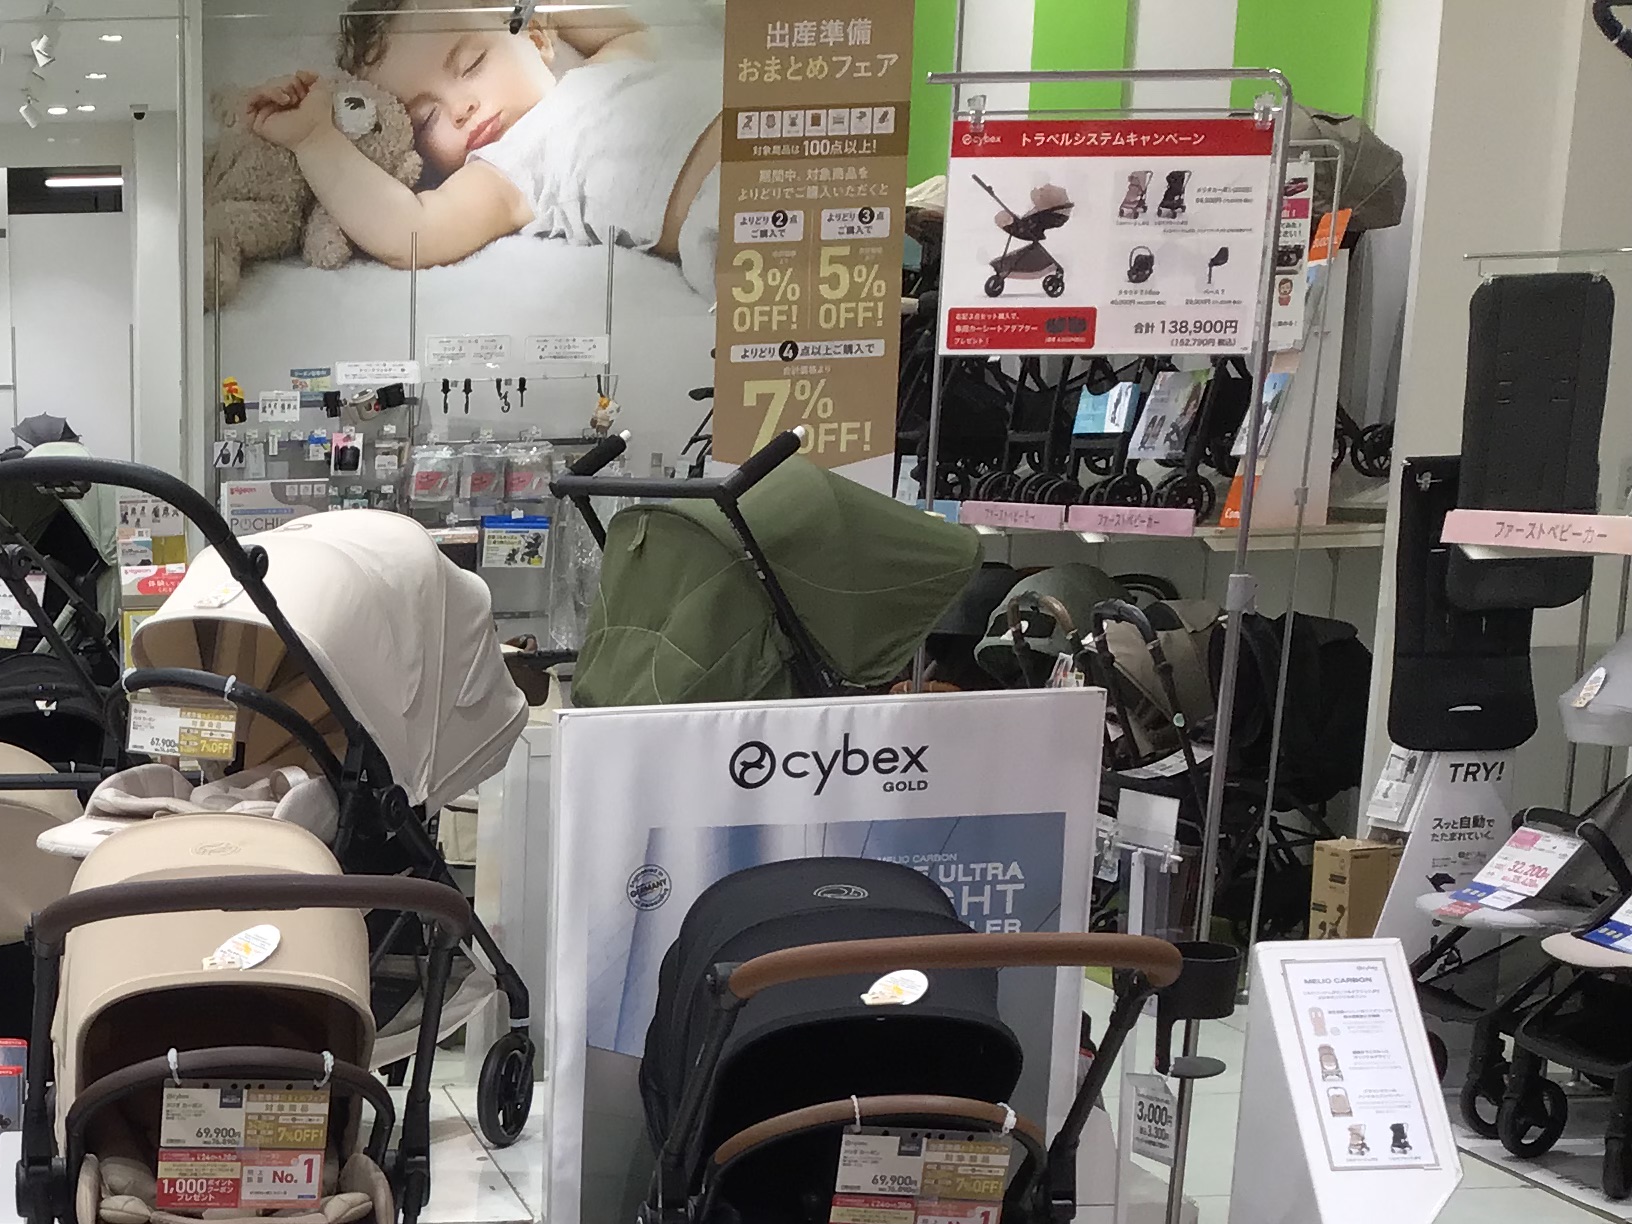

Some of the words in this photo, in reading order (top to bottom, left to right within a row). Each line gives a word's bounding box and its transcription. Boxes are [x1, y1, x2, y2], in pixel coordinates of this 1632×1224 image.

[766, 18, 873, 49] 出産準備
[738, 54, 899, 82] おまとめフェア
[1021, 132, 1206, 147] トラベルシステムキャンペーン
[737, 183, 889, 201] よりどりでご購入いただくと
[733, 304, 799, 332] OFF!
[819, 302, 884, 331] OFF!
[1134, 321, 1155, 334] 合計
[1159, 319, 1239, 336] 138,900円
[797, 420, 872, 455] OFF!
[1494, 520, 1608, 544] ファーストベビーカー
[781, 732, 930, 795] cybex
[1449, 761, 1506, 783] TRY!
[882, 780, 929, 793] GOLD
[1432, 815, 1496, 830] スッと自動で
[913, 853, 958, 864] CARBON
[938, 861, 1026, 883] ULTRA
[277, 1127, 324, 1143] 7%OFF!
[271, 1170, 298, 1185] No.
[303, 1158, 314, 1184] 1
[162, 1178, 207, 1194] 1,000
[955, 1177, 1003, 1194] 7%OFF!
[176, 1193, 216, 1202] プレゼント
